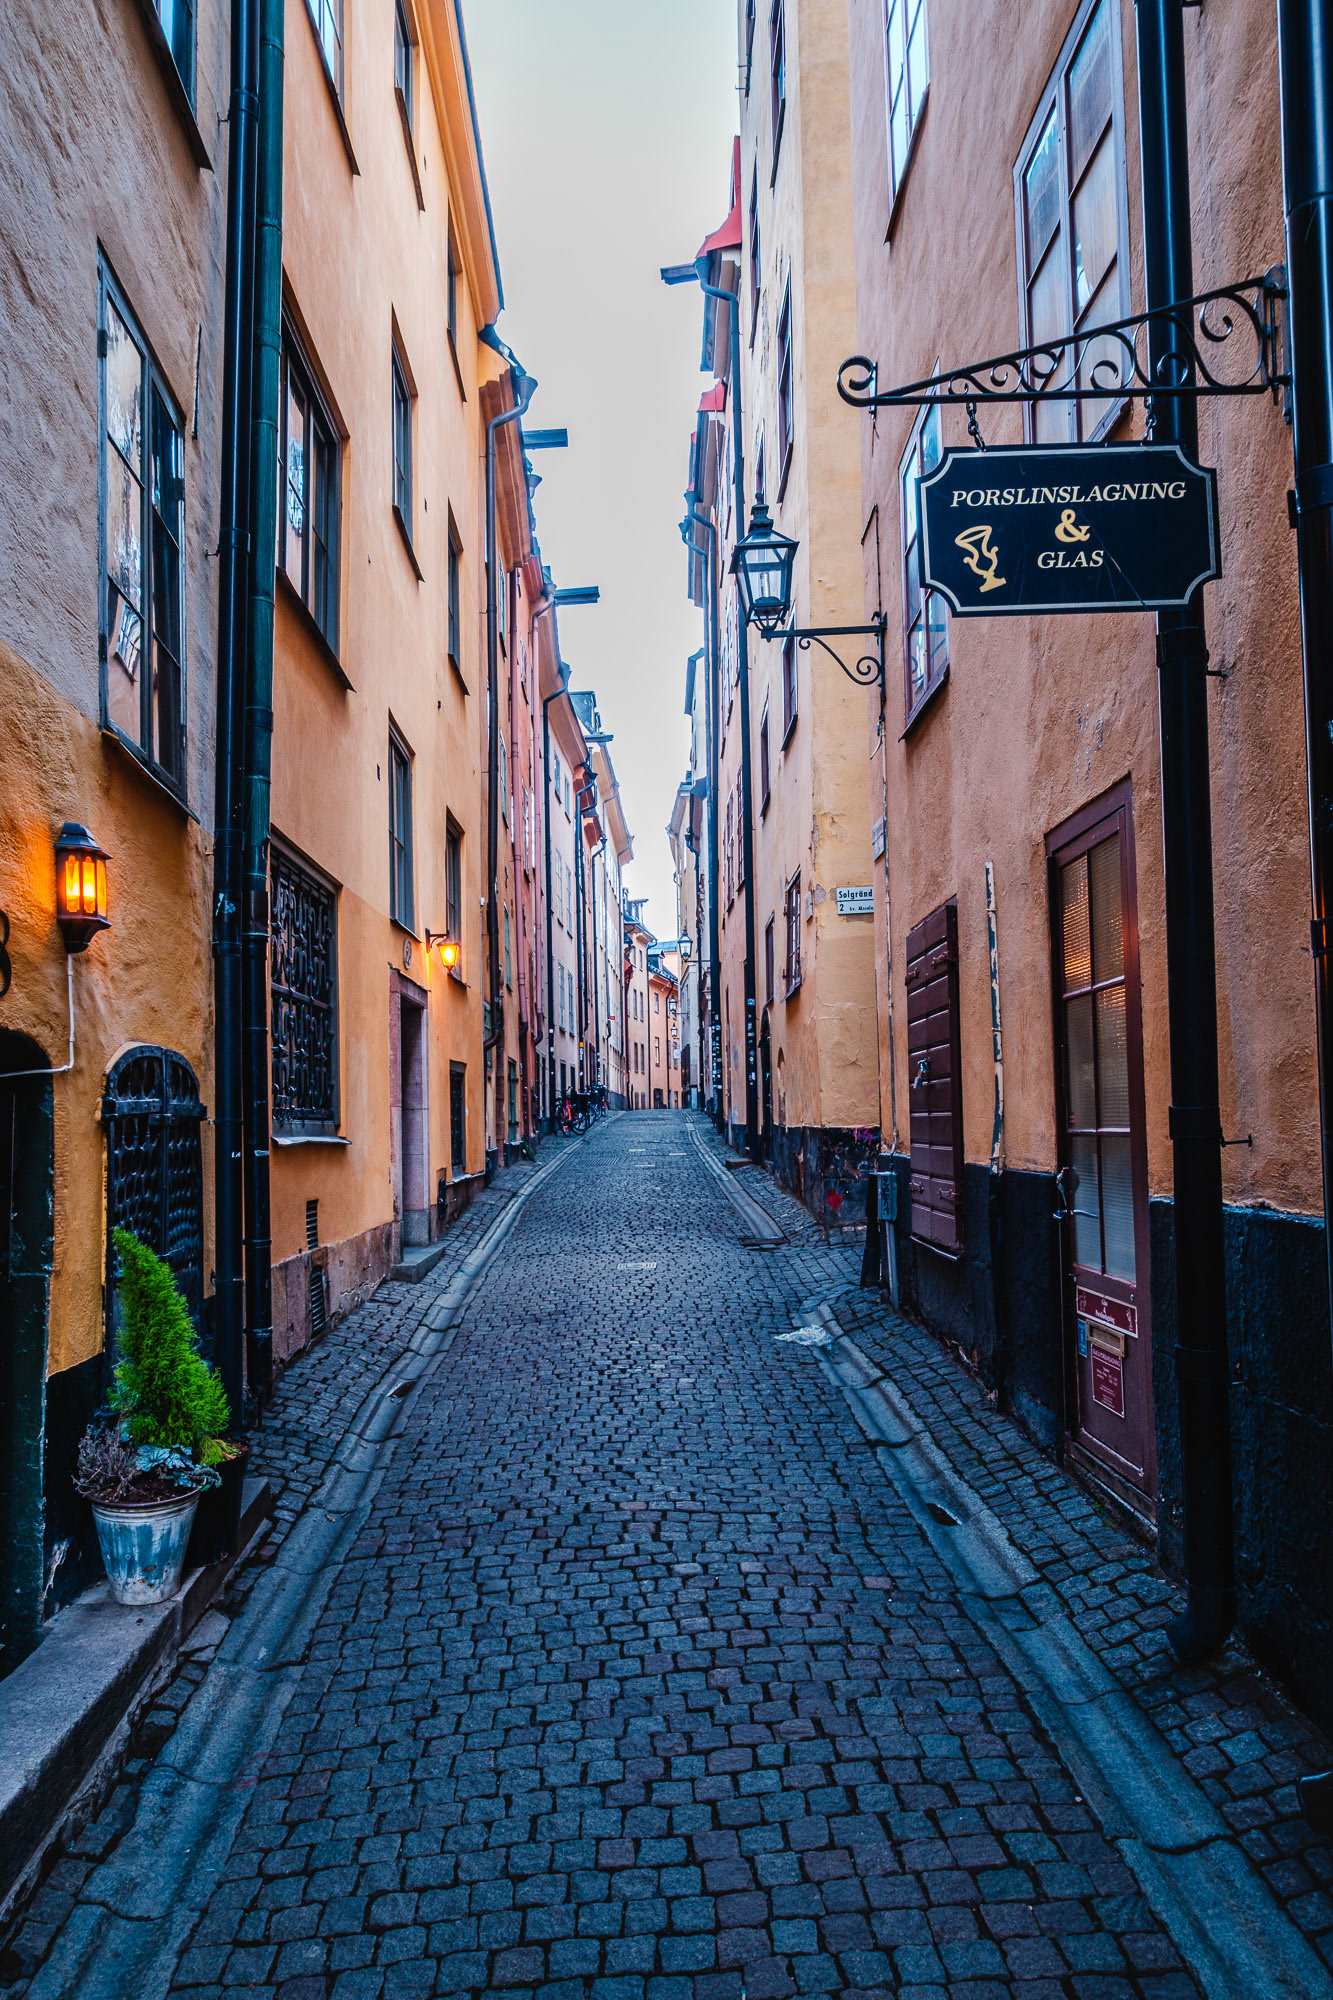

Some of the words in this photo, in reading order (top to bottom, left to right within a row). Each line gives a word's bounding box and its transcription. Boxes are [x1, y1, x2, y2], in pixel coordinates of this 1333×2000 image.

[950, 481, 1187, 507] PORSLINSLAGNING
[1054, 509, 1091, 543] &
[1037, 549, 1105, 569] GLAS
[839, 903, 844, 912] 2
